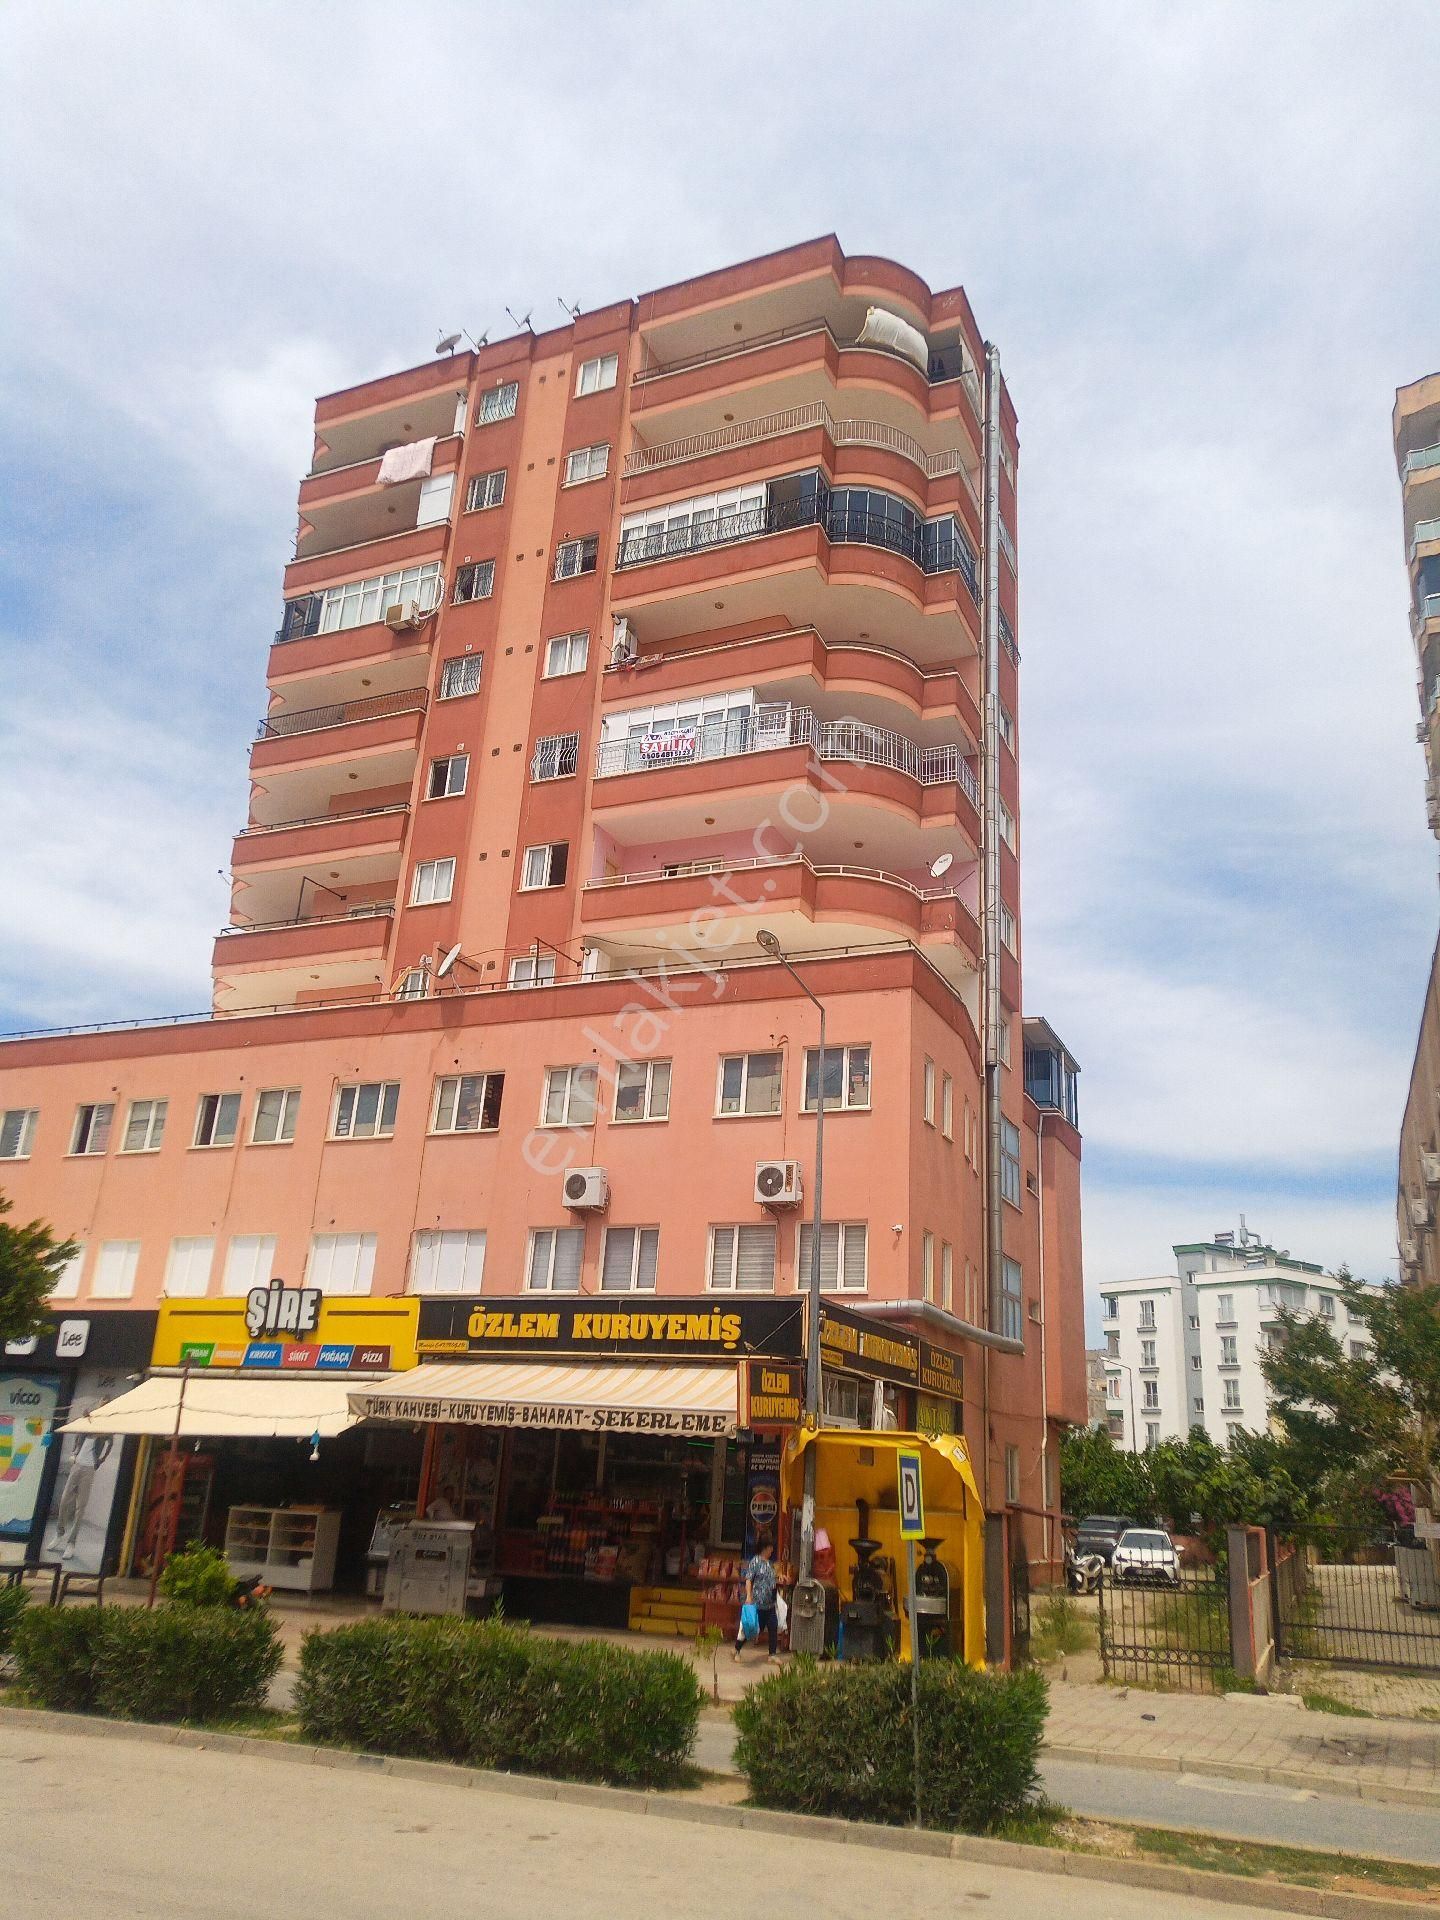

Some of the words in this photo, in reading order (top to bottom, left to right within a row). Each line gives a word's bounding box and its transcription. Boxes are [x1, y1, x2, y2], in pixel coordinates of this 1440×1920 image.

[641, 738, 695, 753] SATILIK
[467, 1305, 560, 1338] ÖZLEM
[571, 1306, 742, 1349] KURUYEMİŞ
[61, 1331, 82, 1346] Lee
[287, 1349, 310, 1362] SİMİT
[360, 1350, 384, 1363] PİZZA
[366, 1396, 391, 1416] TÜRK
[905, 1473, 916, 1514] D
